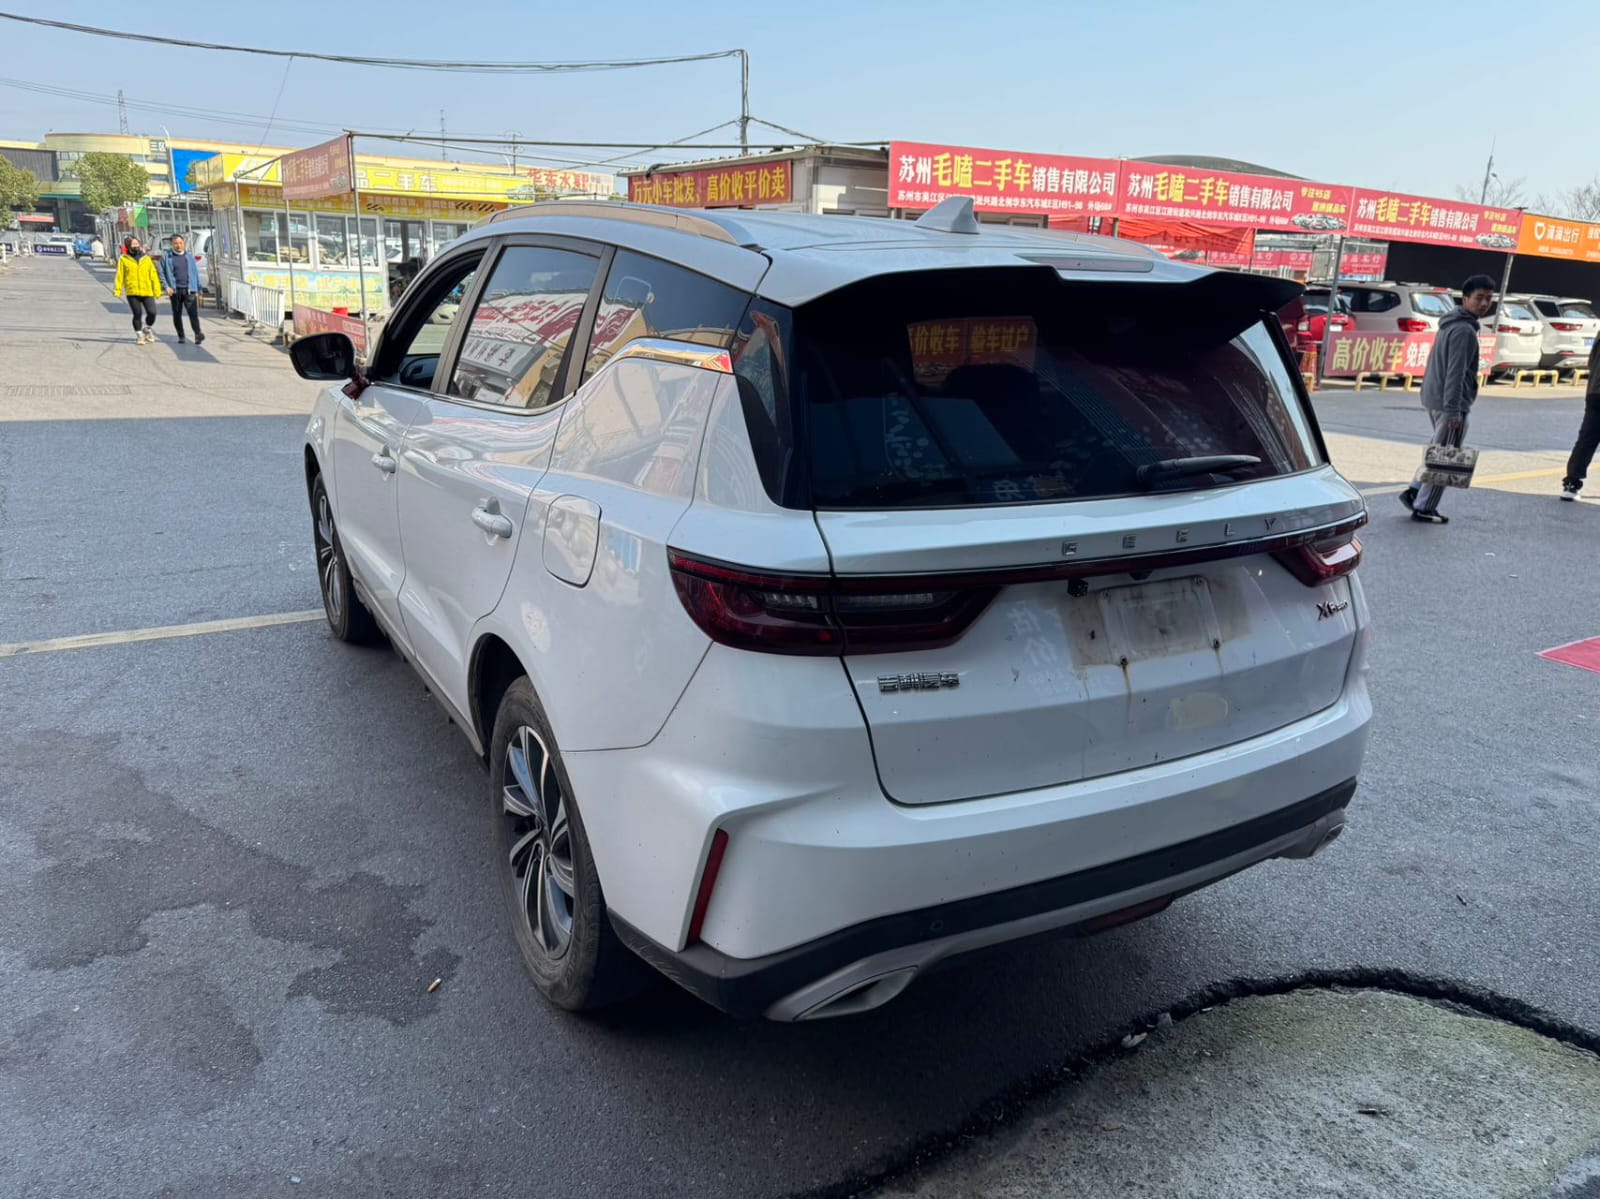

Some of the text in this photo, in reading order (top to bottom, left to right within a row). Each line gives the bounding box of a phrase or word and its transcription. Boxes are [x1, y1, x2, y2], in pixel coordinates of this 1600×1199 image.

[707, 166, 785, 201] 高价收平价卖
[910, 324, 961, 355] 价收车
[1332, 337, 1405, 372] 高价收车
[1062, 517, 1276, 556] GEELY
